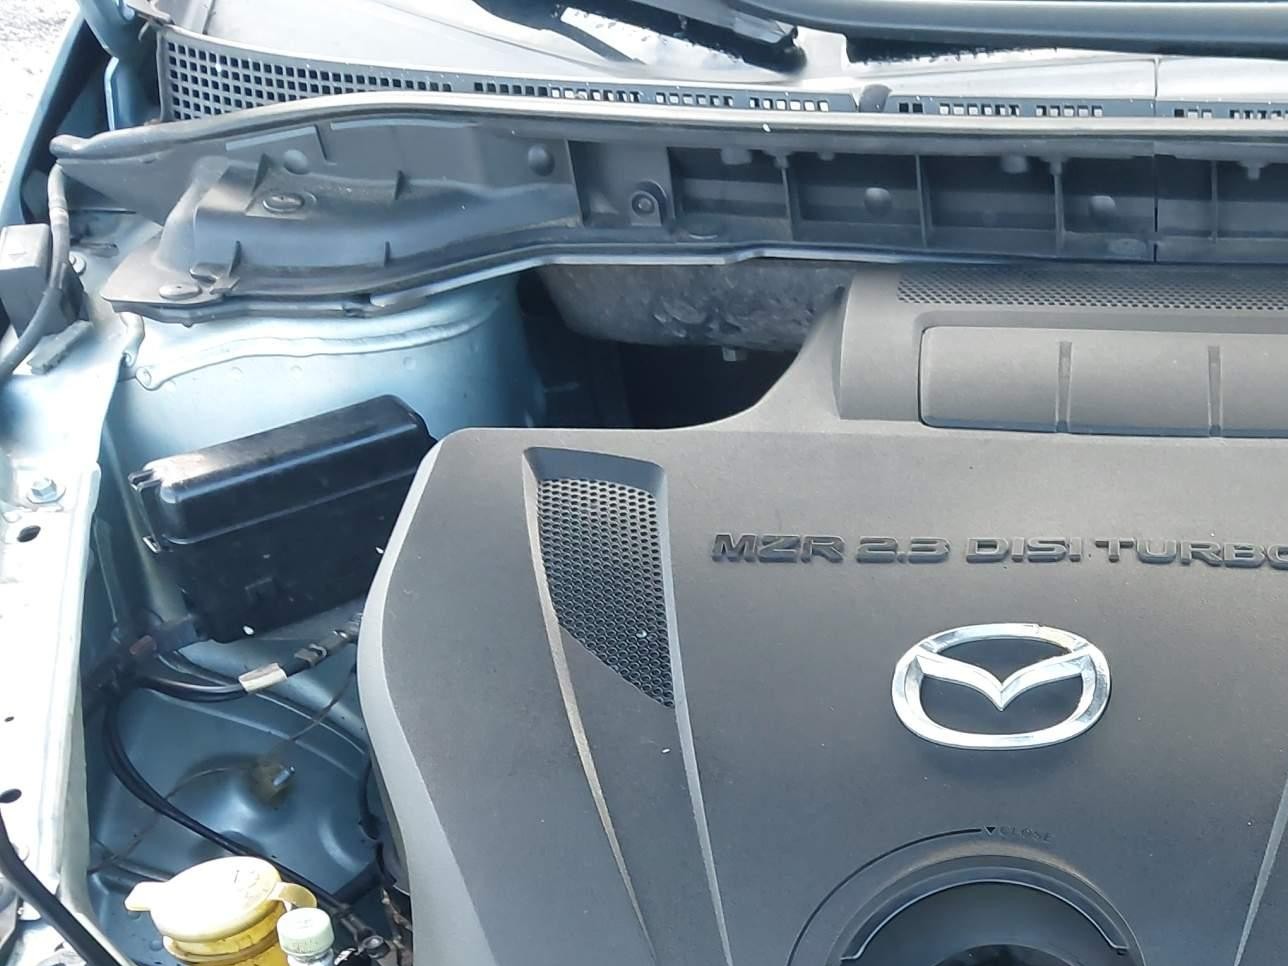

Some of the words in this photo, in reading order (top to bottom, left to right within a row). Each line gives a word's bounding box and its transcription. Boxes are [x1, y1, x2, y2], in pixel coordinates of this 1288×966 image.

[711, 533, 844, 563] MZR
[856, 536, 951, 564] 2.3
[966, 536, 1083, 564] DISI
